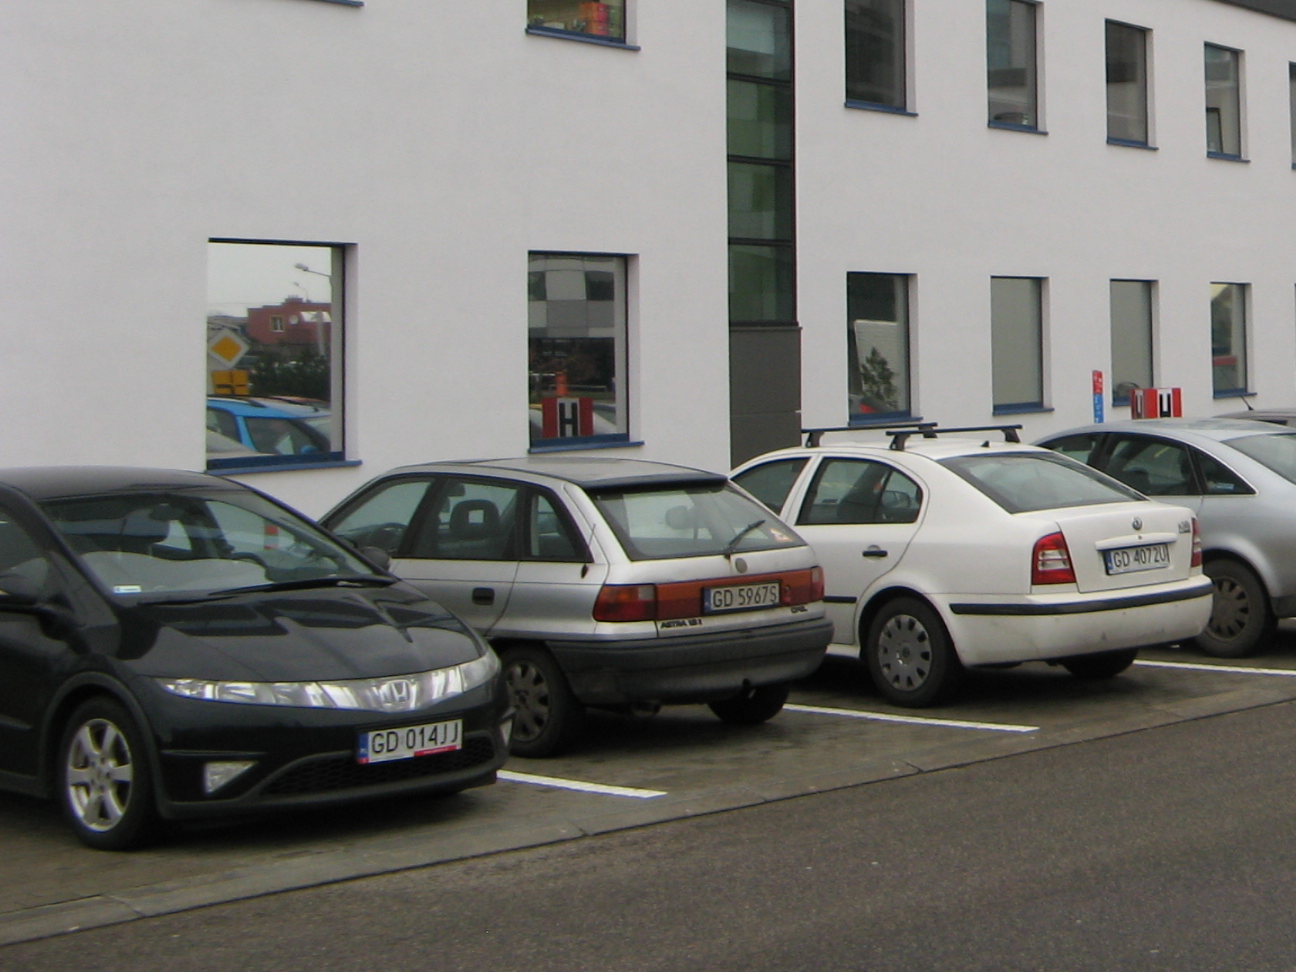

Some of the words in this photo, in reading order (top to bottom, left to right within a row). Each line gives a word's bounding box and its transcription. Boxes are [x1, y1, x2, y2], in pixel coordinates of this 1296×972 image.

[559, 402, 579, 437] H
[1113, 550, 1131, 568] GD
[712, 589, 734, 608] GD
[738, 585, 778, 607] 5967S
[371, 731, 399, 754] GD
[405, 721, 459, 749] 014JJ
